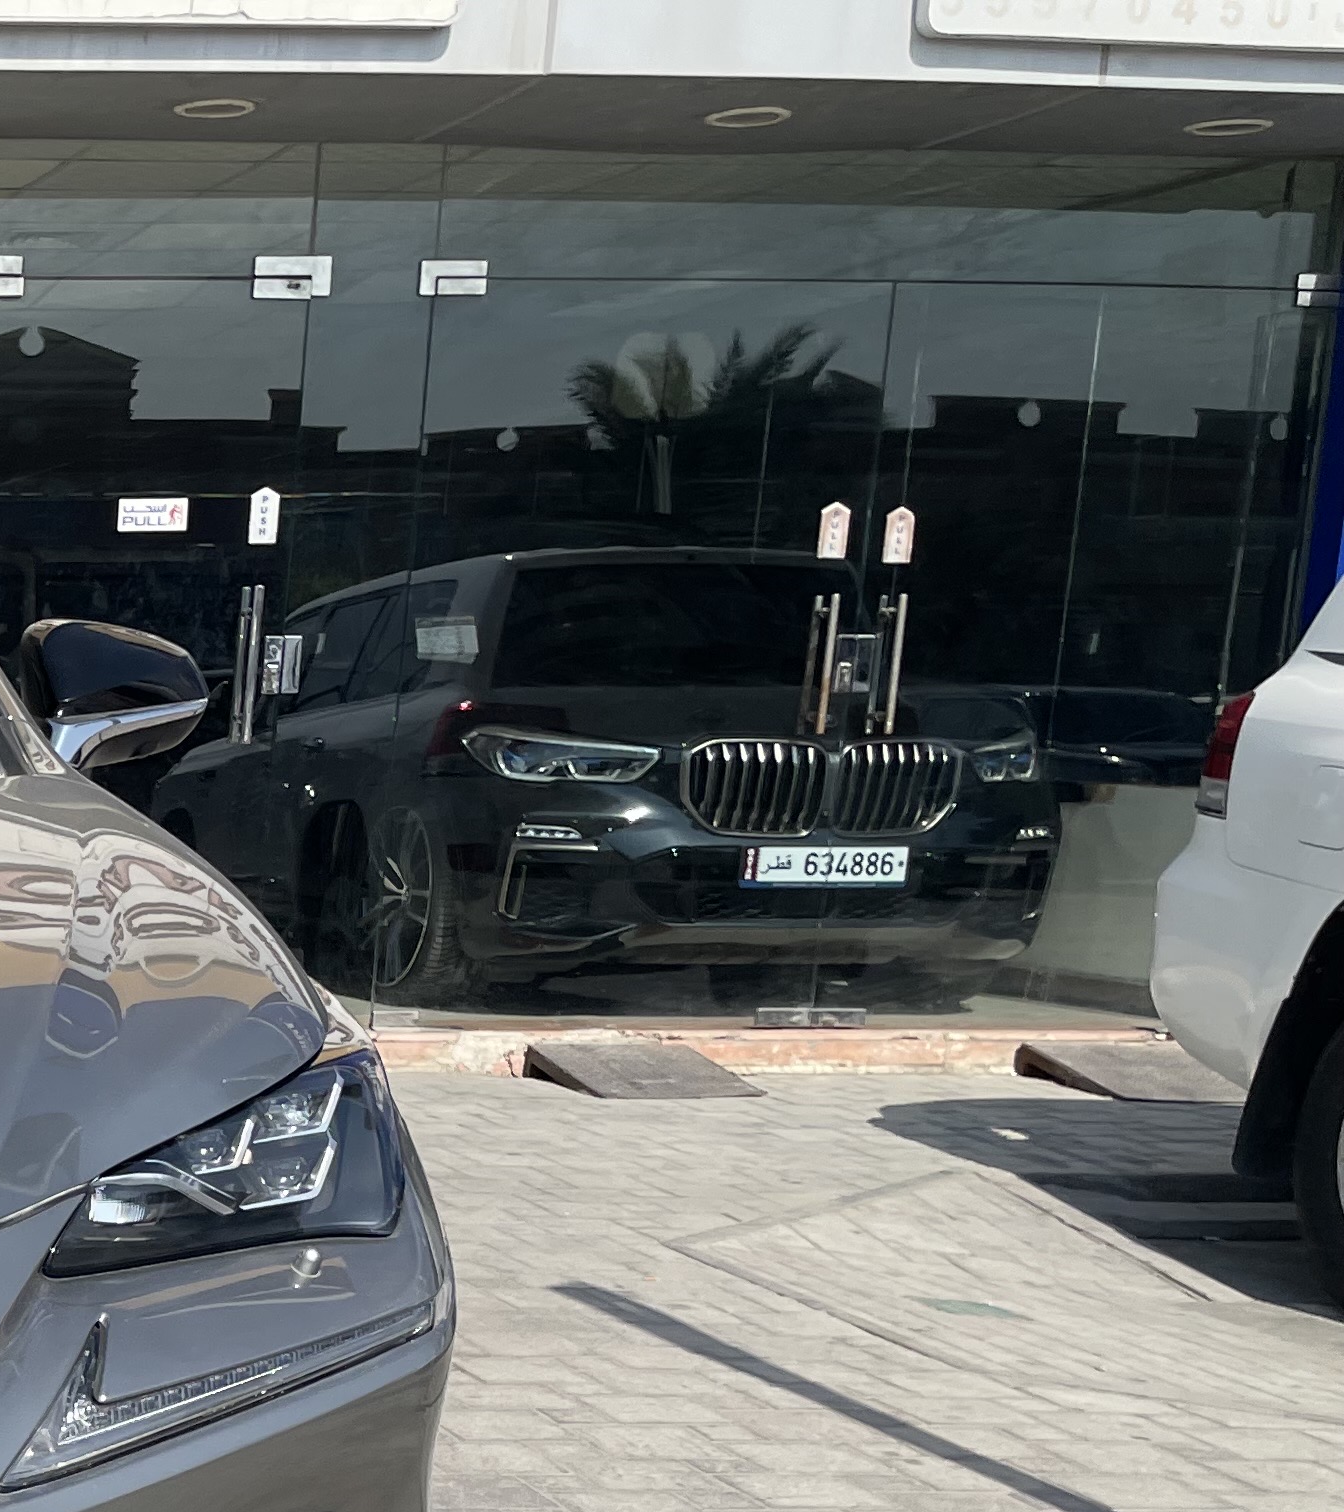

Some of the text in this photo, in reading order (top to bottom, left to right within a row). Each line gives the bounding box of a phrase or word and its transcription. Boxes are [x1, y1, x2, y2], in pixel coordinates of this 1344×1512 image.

[122, 516, 168, 526] PULL
[758, 854, 792, 874] قطر
[804, 852, 894, 876] 634886
